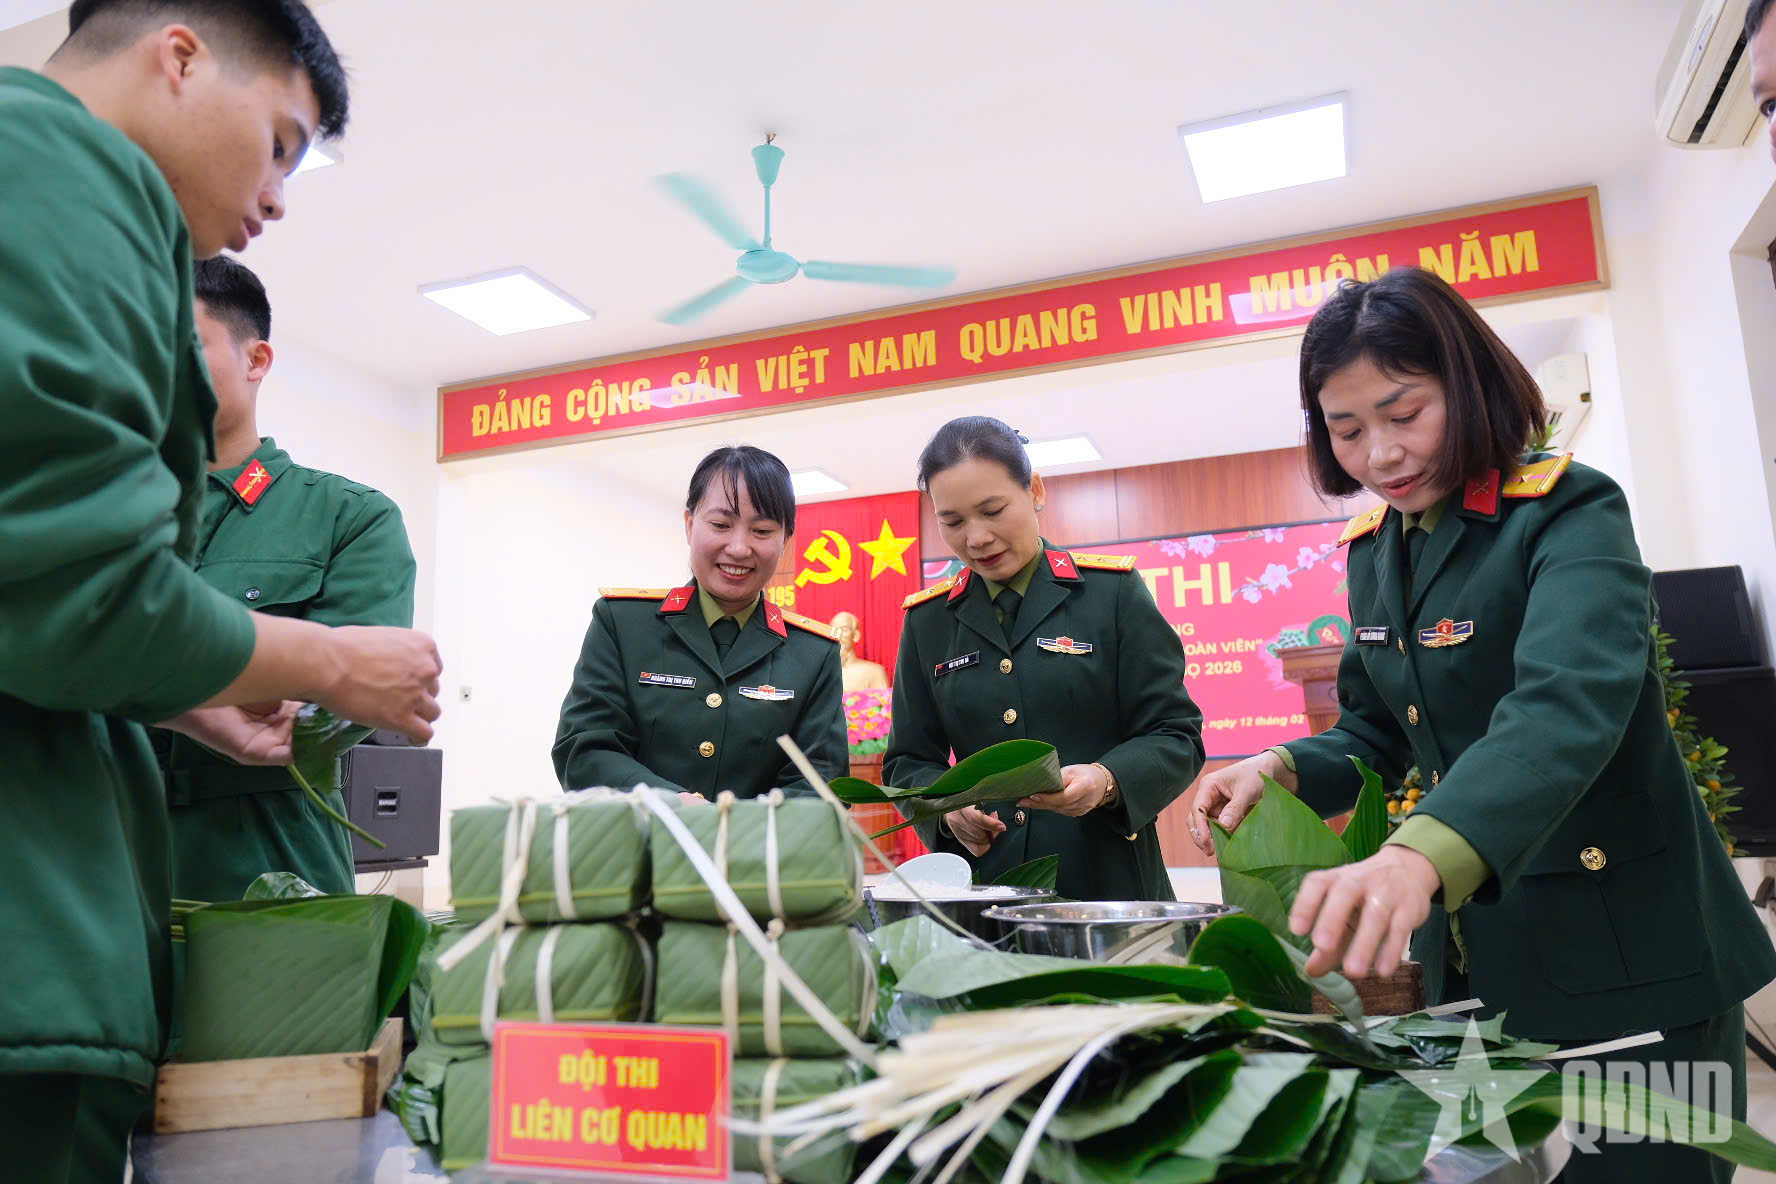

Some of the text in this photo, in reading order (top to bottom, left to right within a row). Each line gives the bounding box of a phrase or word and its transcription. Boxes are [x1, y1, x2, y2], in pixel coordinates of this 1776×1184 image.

[471, 389, 551, 437] ĐẢNG
[566, 378, 652, 425] CỘNG
[671, 355, 739, 405] SẢN
[755, 345, 830, 394] VIỆT
[848, 329, 937, 379] NAM
[959, 303, 1098, 364] QUANG
[1119, 281, 1224, 335] VINH
[1418, 229, 1540, 285] NĂM
[1138, 561, 1232, 608] THI
[1184, 641, 1217, 656] OÀN
[1205, 660, 1243, 675] 2026
[1208, 717, 1237, 730] ngày
[1240, 716, 1253, 727] 12
[1255, 715, 1288, 727] tháng
[558, 1048, 660, 1091] ĐỘI THI
[510, 1097, 708, 1152] LIÊN CƠ QUAN
